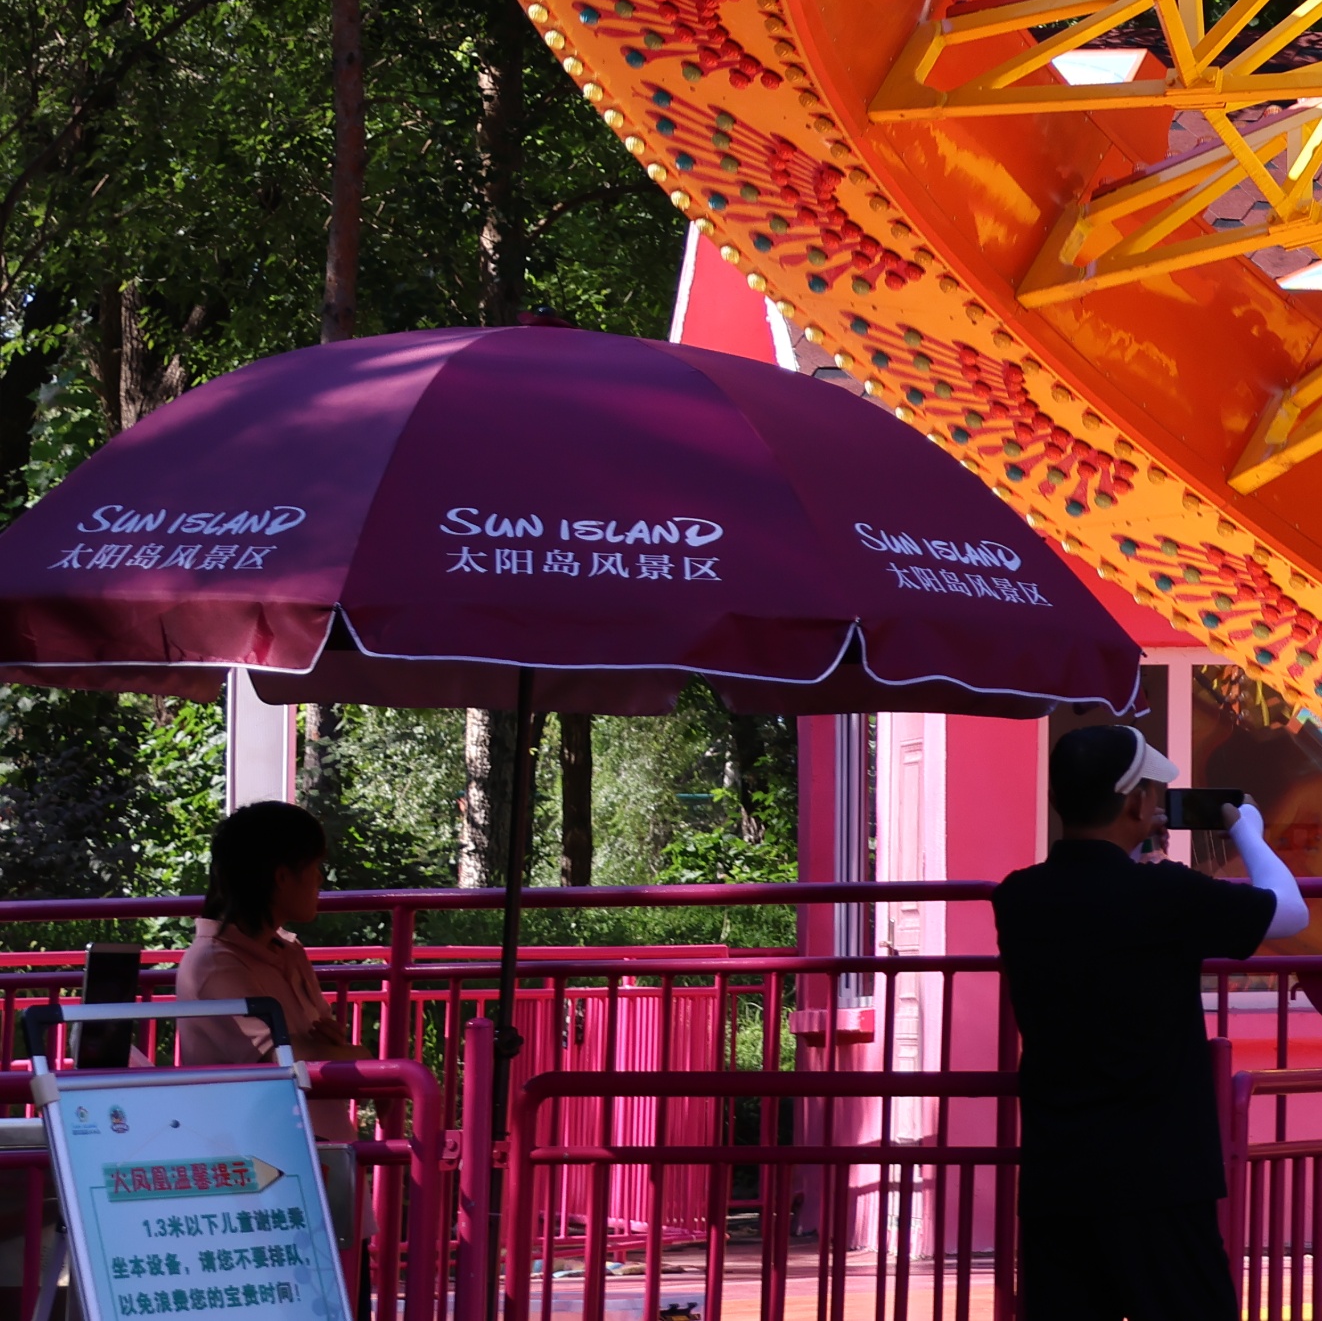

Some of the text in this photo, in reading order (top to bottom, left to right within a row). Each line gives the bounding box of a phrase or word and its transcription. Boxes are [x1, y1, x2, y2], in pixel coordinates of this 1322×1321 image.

[77, 505, 307, 535] SUN ISLAND
[440, 507, 723, 547] SUN ISLAND
[47, 543, 277, 570] 太阳岛风景区
[446, 546, 722, 581] 太阳岛风景区
[854, 522, 1022, 572] SUN ISLAND
[886, 562, 1053, 607] 太阳岛风景区
[111, 1161, 251, 1194] 火凤凰温馨提示
